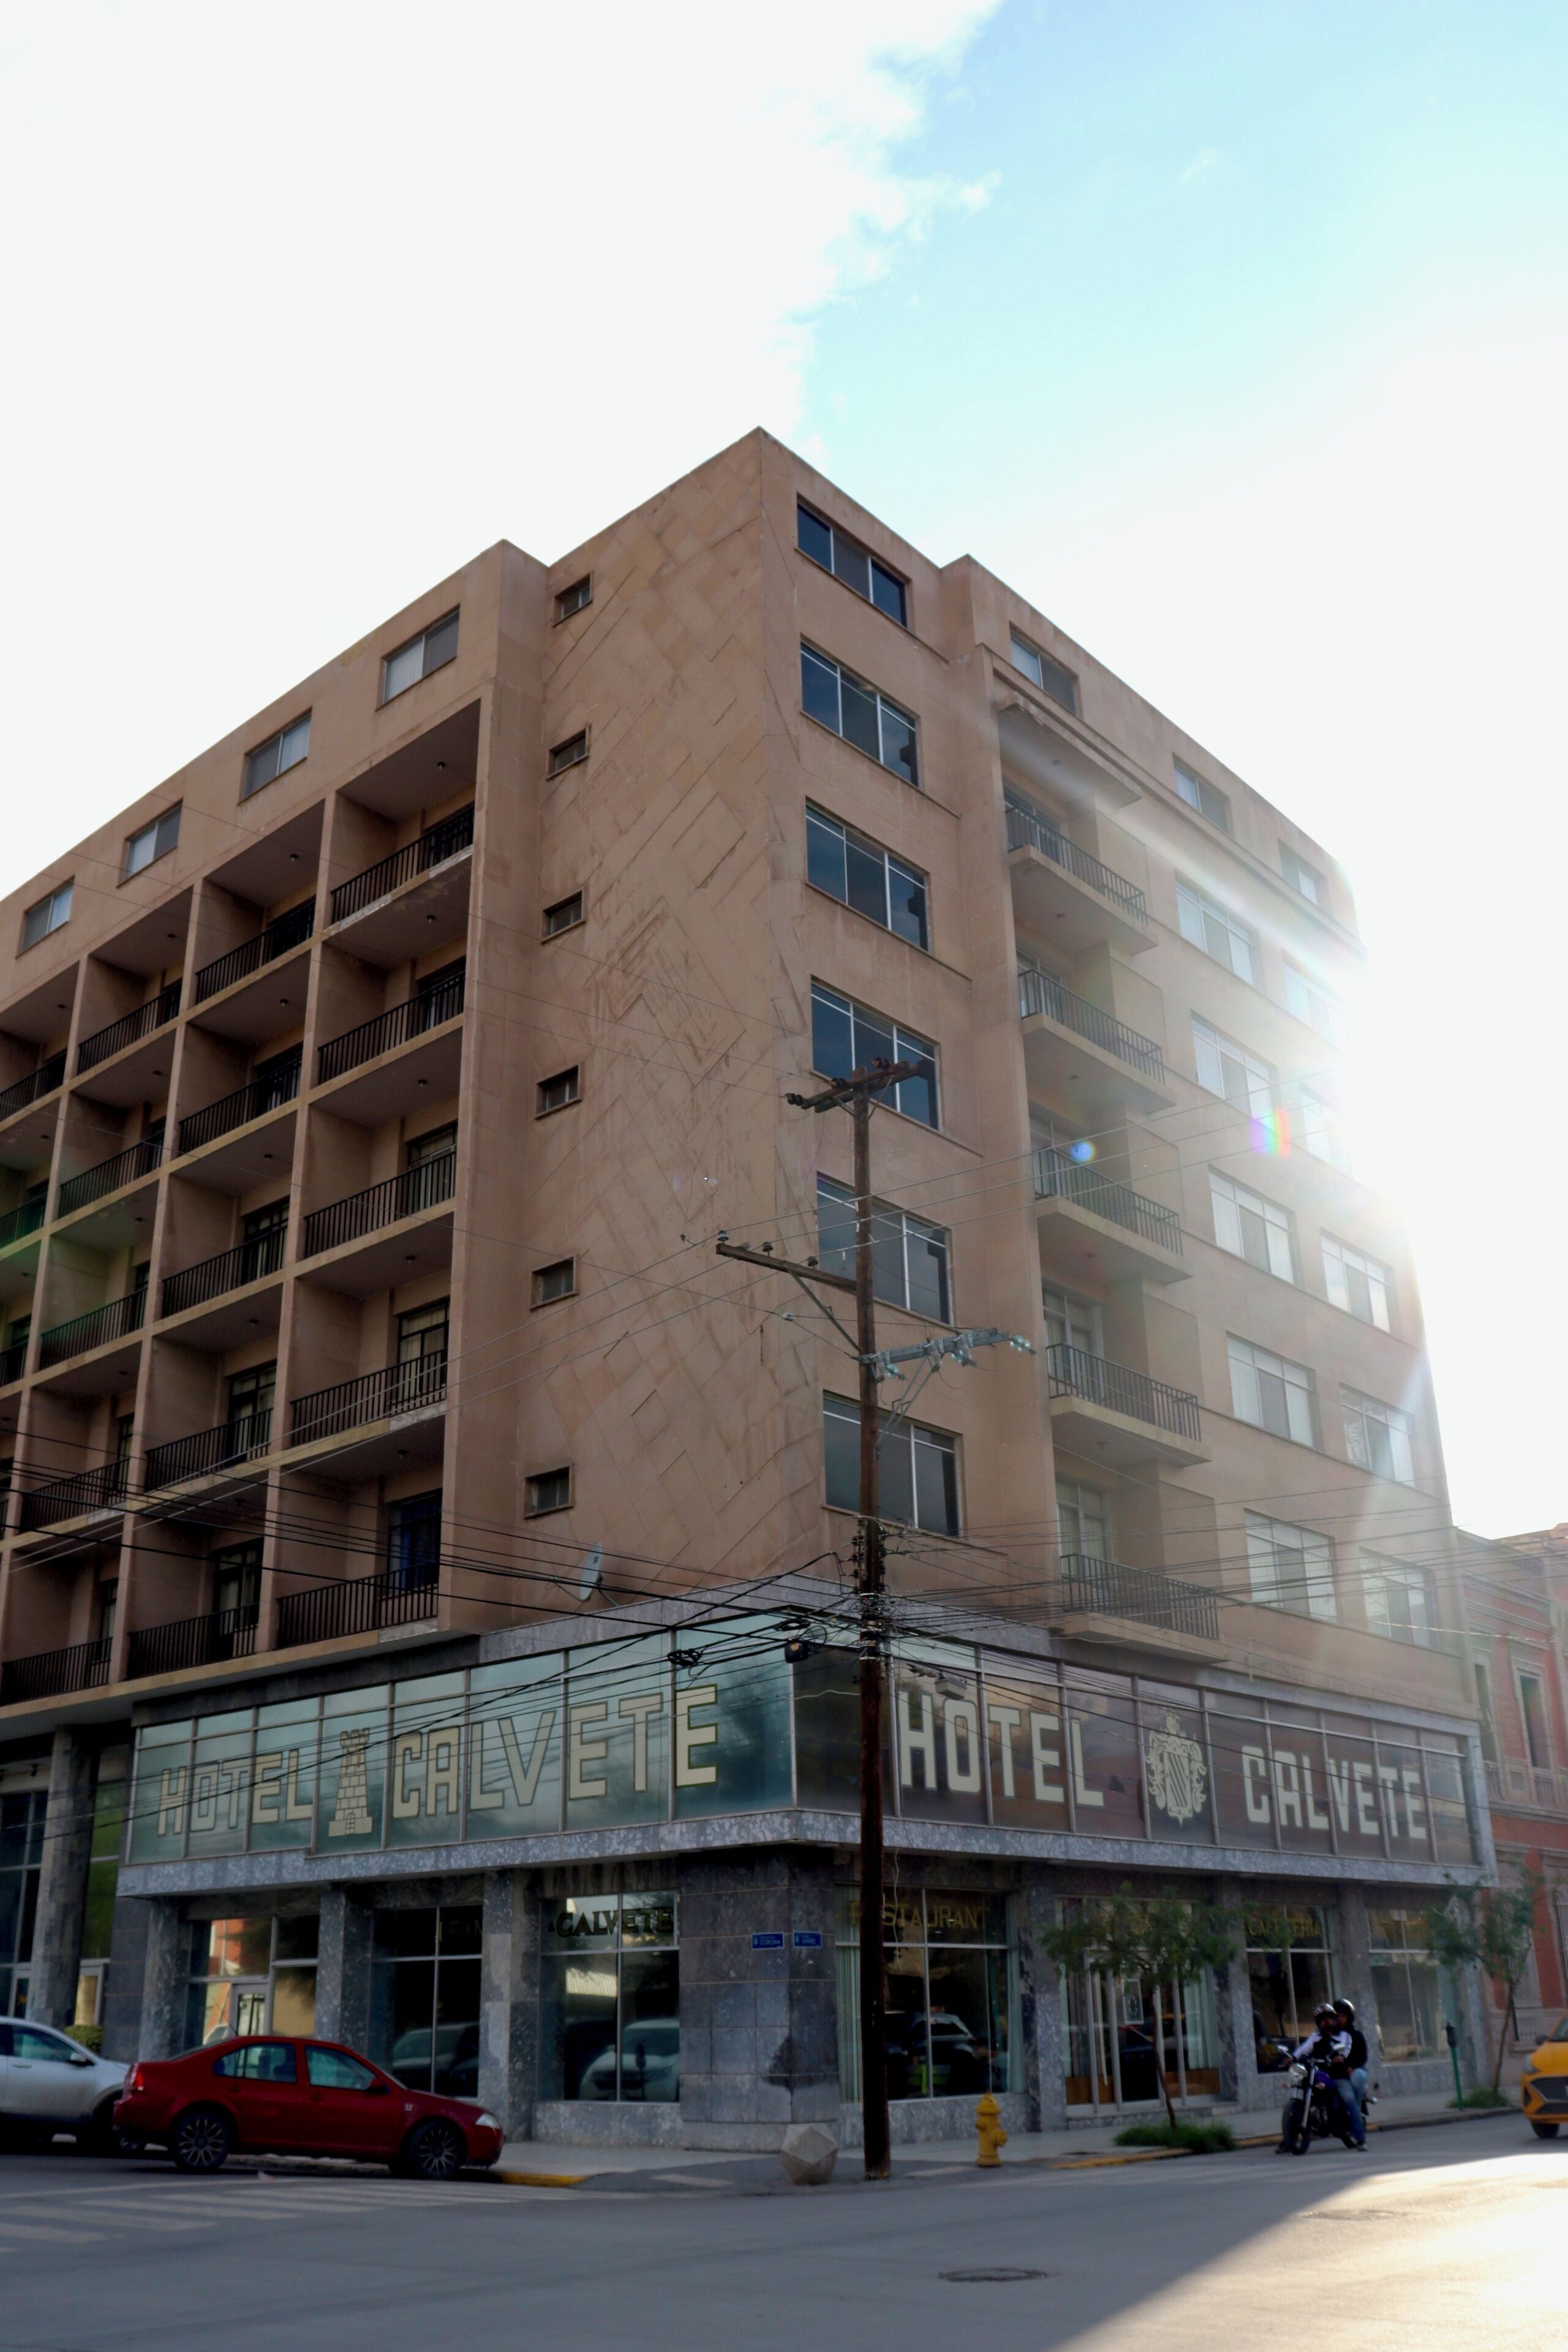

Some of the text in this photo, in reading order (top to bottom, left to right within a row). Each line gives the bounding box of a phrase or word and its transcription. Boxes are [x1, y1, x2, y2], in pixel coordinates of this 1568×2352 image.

[157, 1683, 718, 1836] HOTEL CALVETE
[899, 1689, 1427, 1839] HOTEL CALVETE
[556, 1907, 673, 1937] CALVETE
[848, 1901, 990, 1929] RSTAURANT
